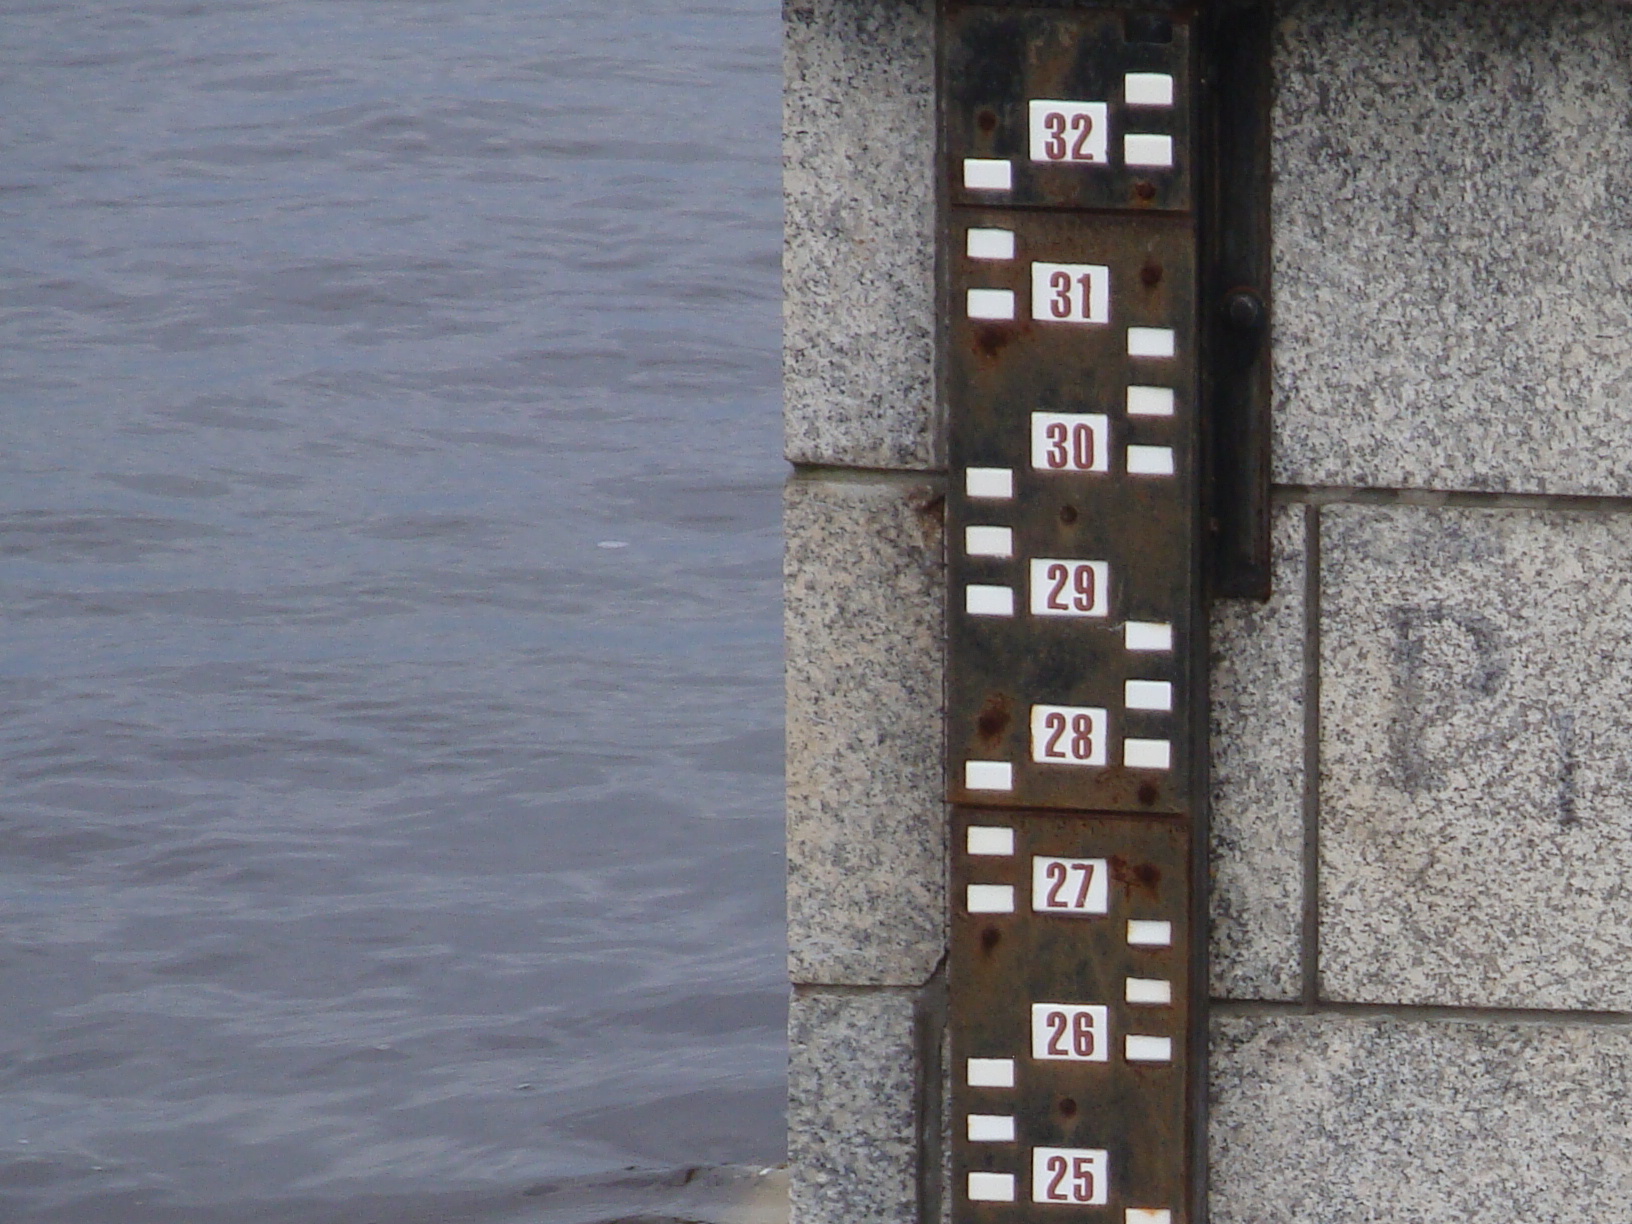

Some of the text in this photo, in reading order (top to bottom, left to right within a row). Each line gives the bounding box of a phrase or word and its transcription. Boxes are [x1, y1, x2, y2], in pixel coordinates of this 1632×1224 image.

[1044, 112, 1093, 161] 32
[1049, 271, 1092, 320] 31
[1045, 422, 1095, 470] 30
[1047, 563, 1095, 612] 29
[1044, 713, 1093, 760] 28
[1045, 861, 1095, 909] 27
[1046, 1011, 1094, 1057] 26
[1046, 1155, 1094, 1202] 25
